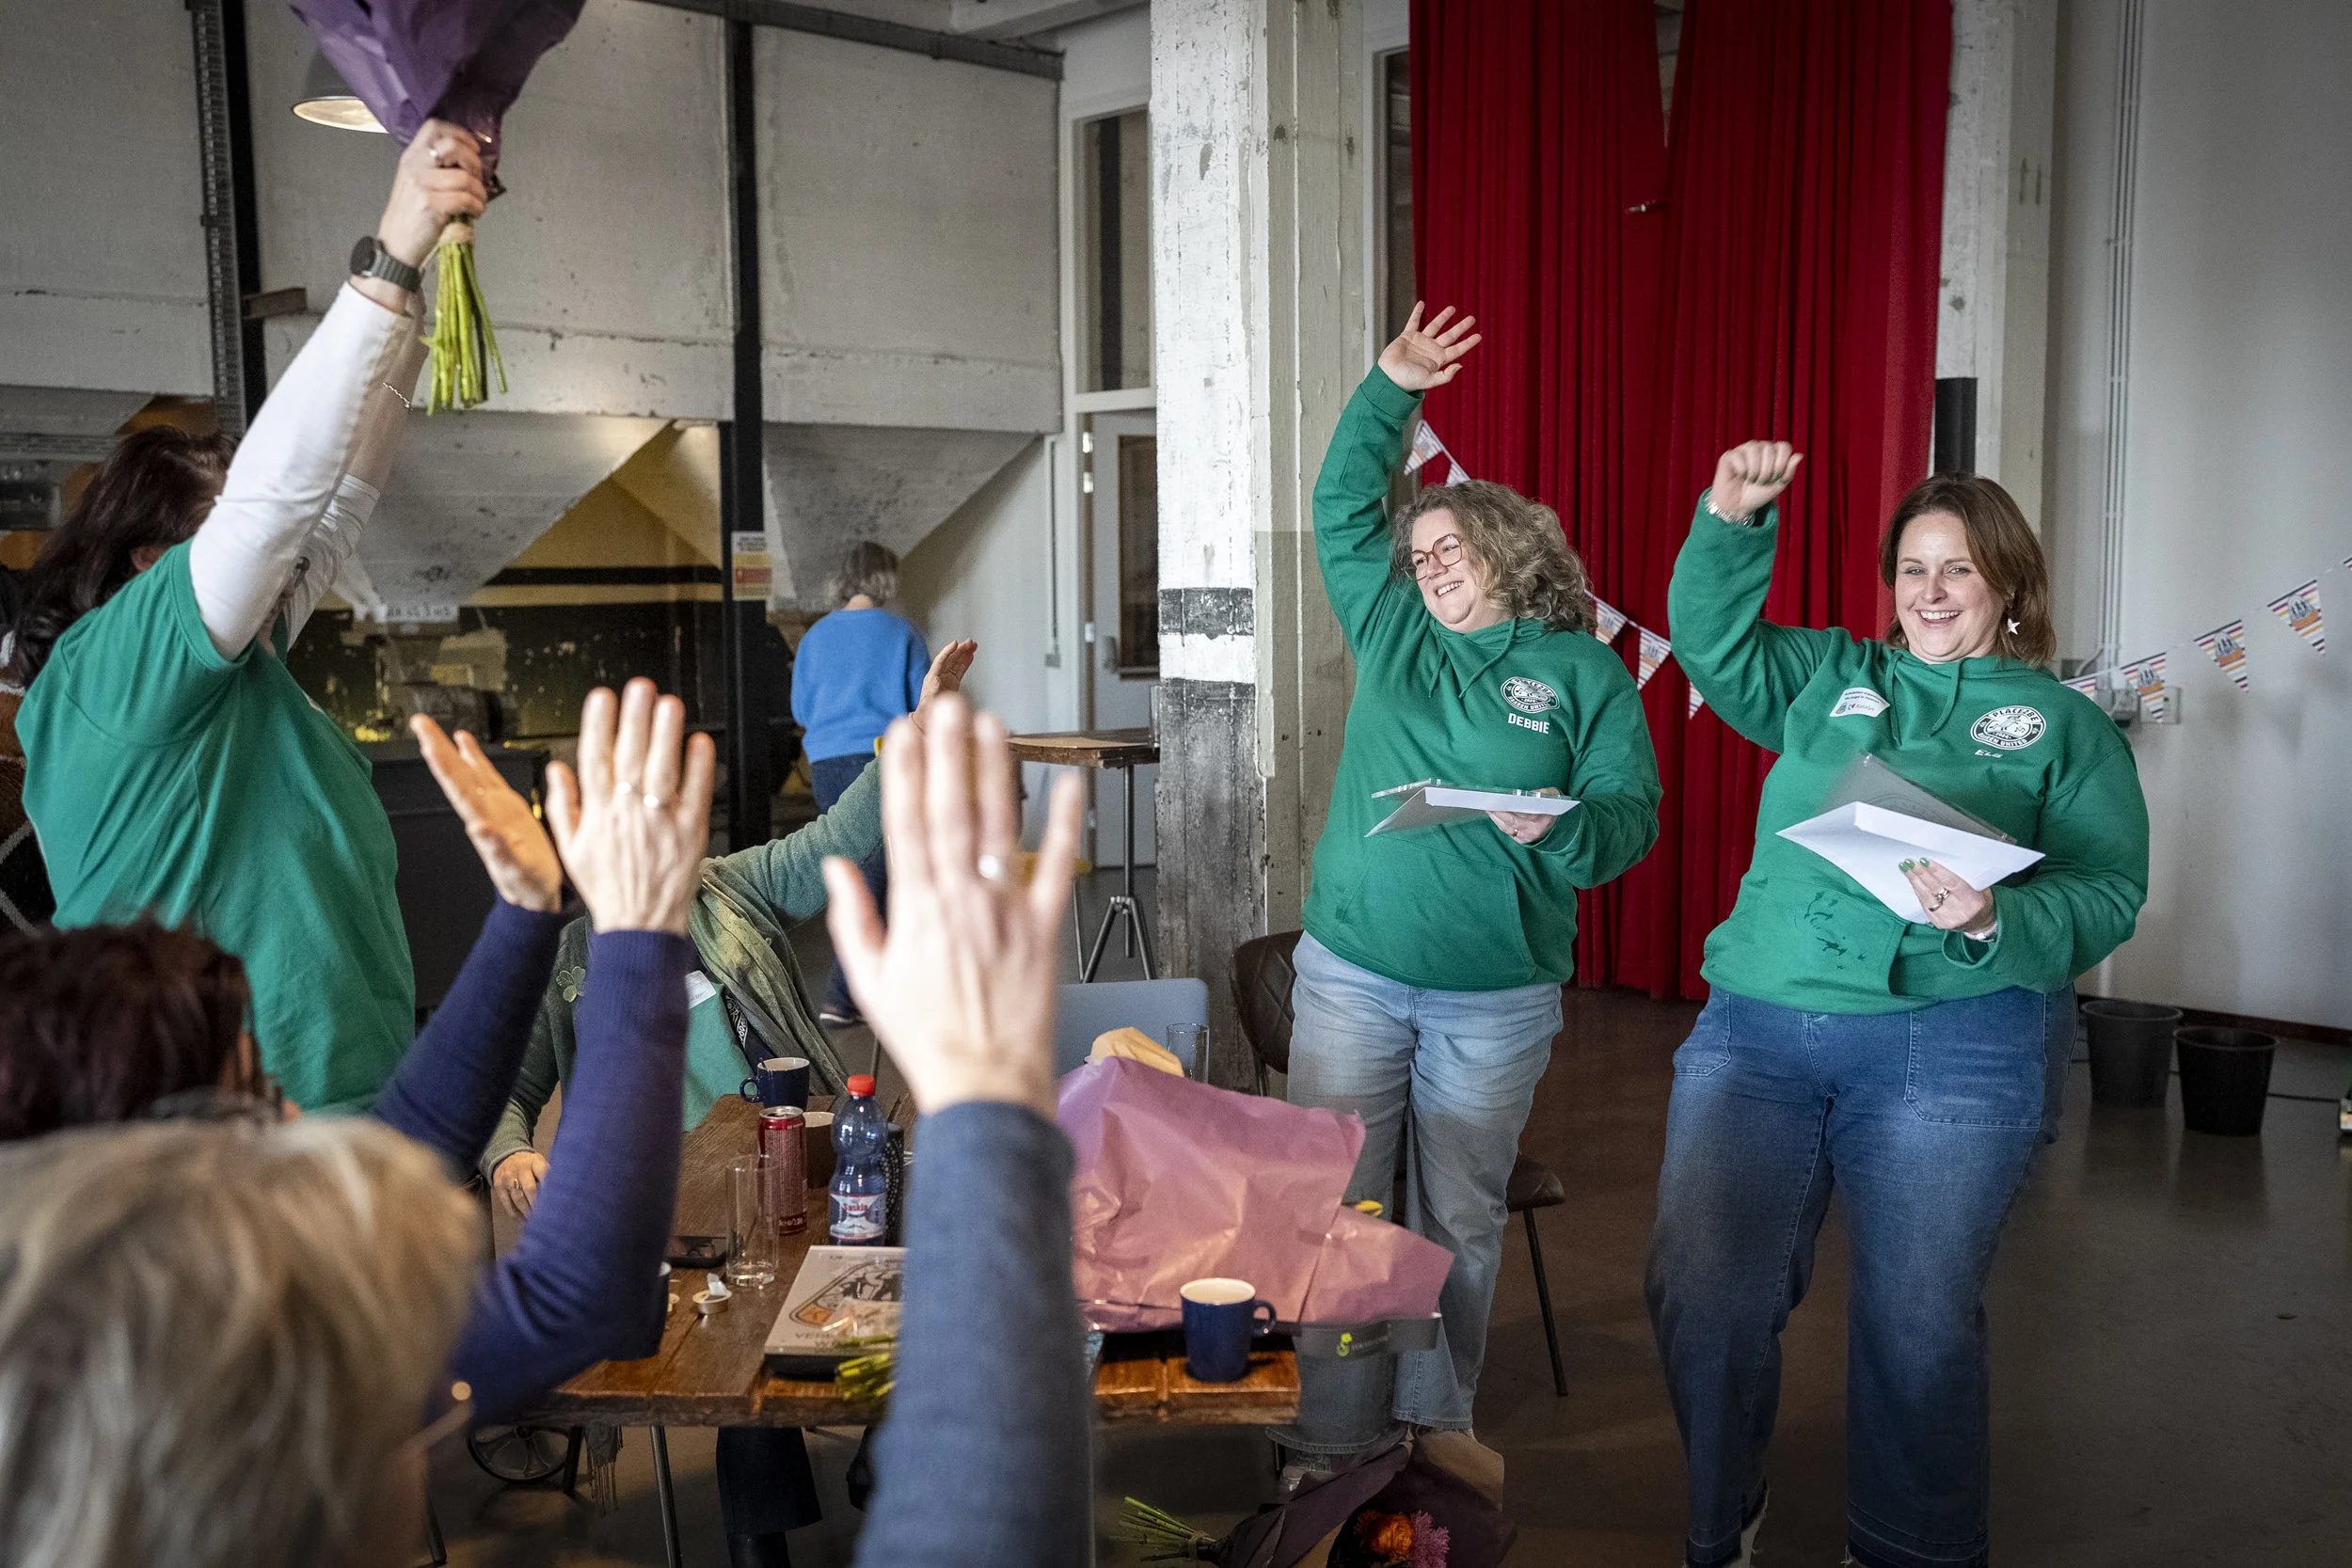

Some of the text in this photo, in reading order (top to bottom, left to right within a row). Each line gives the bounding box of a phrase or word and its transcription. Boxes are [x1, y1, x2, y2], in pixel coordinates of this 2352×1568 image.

[1993, 708, 2039, 721] PLACE2BE
[1508, 713, 1549, 735] DEBBIE
[2000, 738, 2027, 747] UNITED
